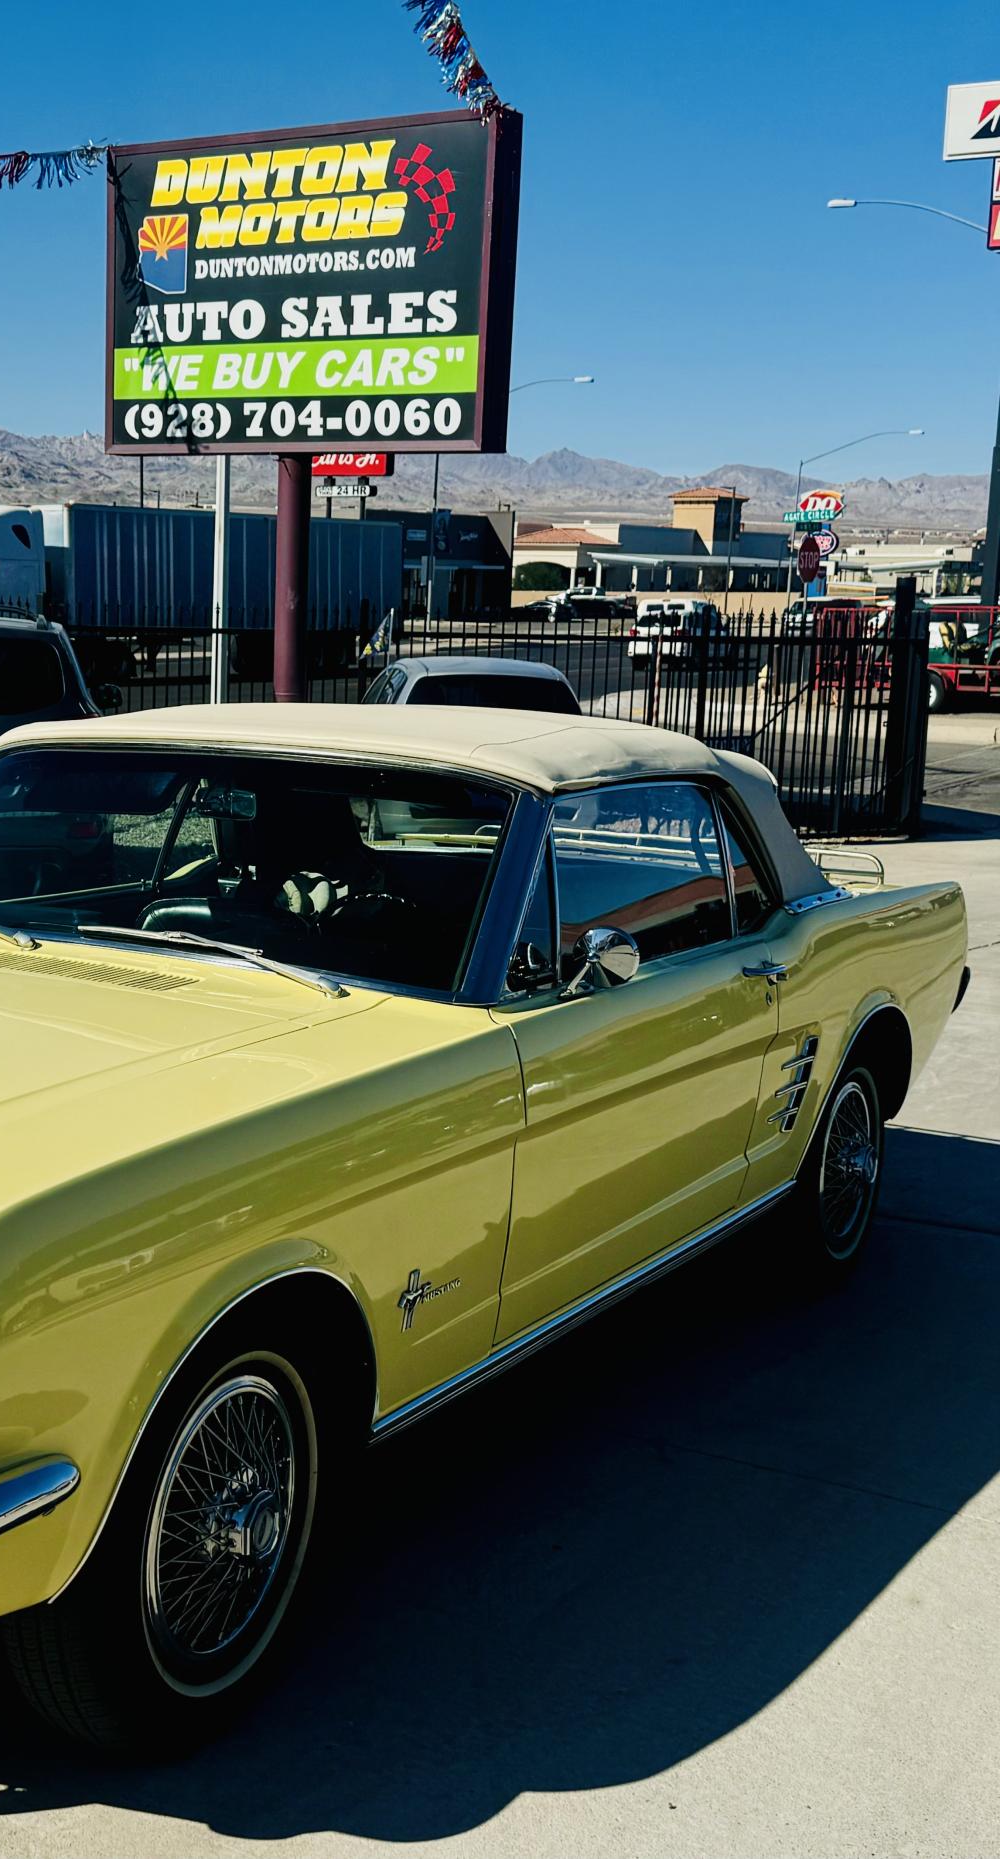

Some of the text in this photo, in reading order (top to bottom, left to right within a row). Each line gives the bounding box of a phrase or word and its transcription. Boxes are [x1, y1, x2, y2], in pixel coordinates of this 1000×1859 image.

[151, 139, 396, 207] DUNTON
[196, 191, 408, 249] MOTORS
[194, 247, 416, 280] DUNTONMOTORS.COM
[131, 290, 458, 343] AUTO SALES
[212, 351, 306, 390] BUY
[315, 347, 465, 387] CARS"
[124, 397, 462, 440] (928) 704-0060
[353, 485, 367, 495] HR
[808, 510, 834, 519] CIRCLE
[800, 552, 819, 568] STOP
